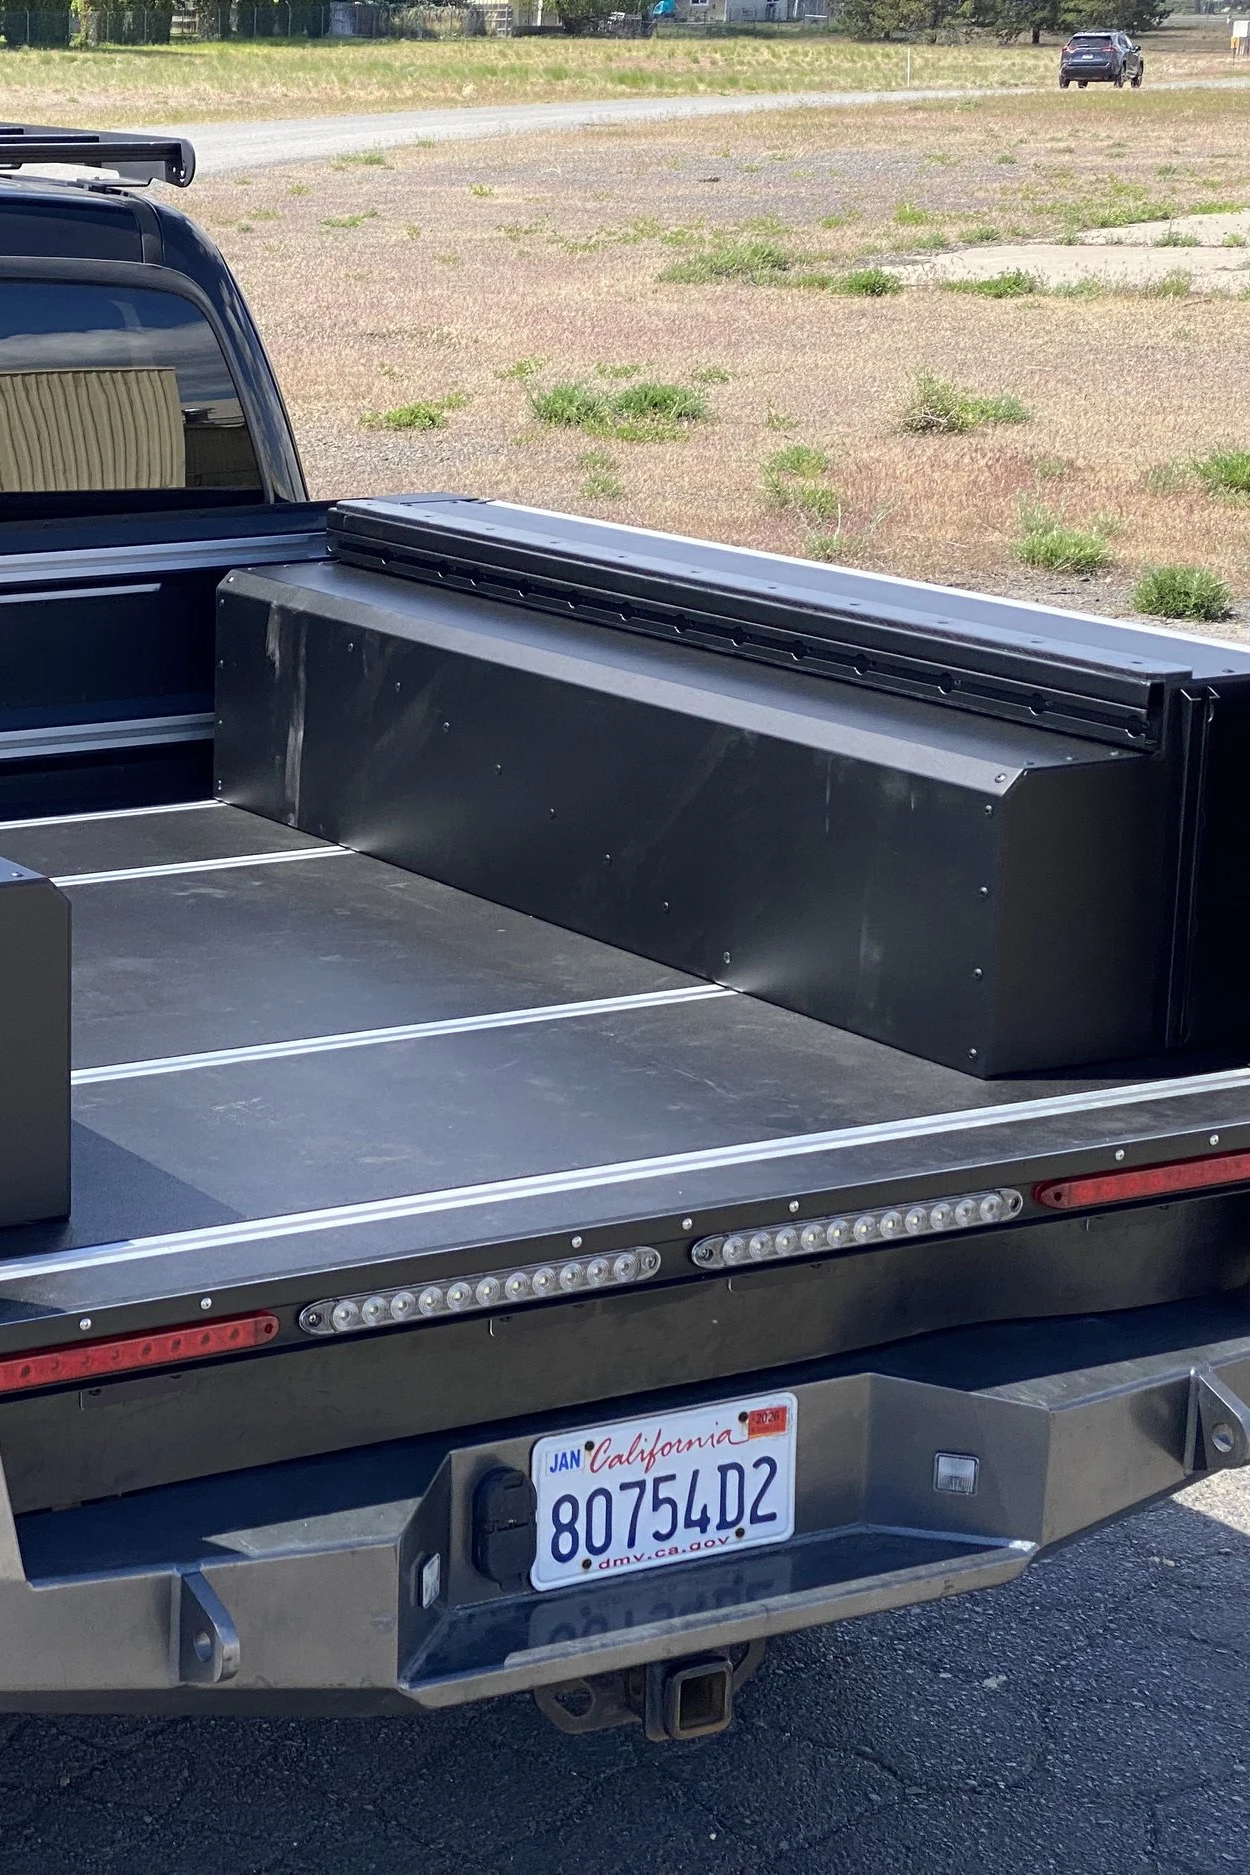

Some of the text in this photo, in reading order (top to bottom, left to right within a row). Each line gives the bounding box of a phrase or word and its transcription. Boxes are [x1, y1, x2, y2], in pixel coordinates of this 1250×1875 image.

[756, 1411, 780, 1424] 2026
[550, 1449, 581, 1473] JAN
[589, 1421, 750, 1474] California
[551, 1455, 778, 1563] 80754D2
[598, 1536, 730, 1569] dmv.ca.gov
